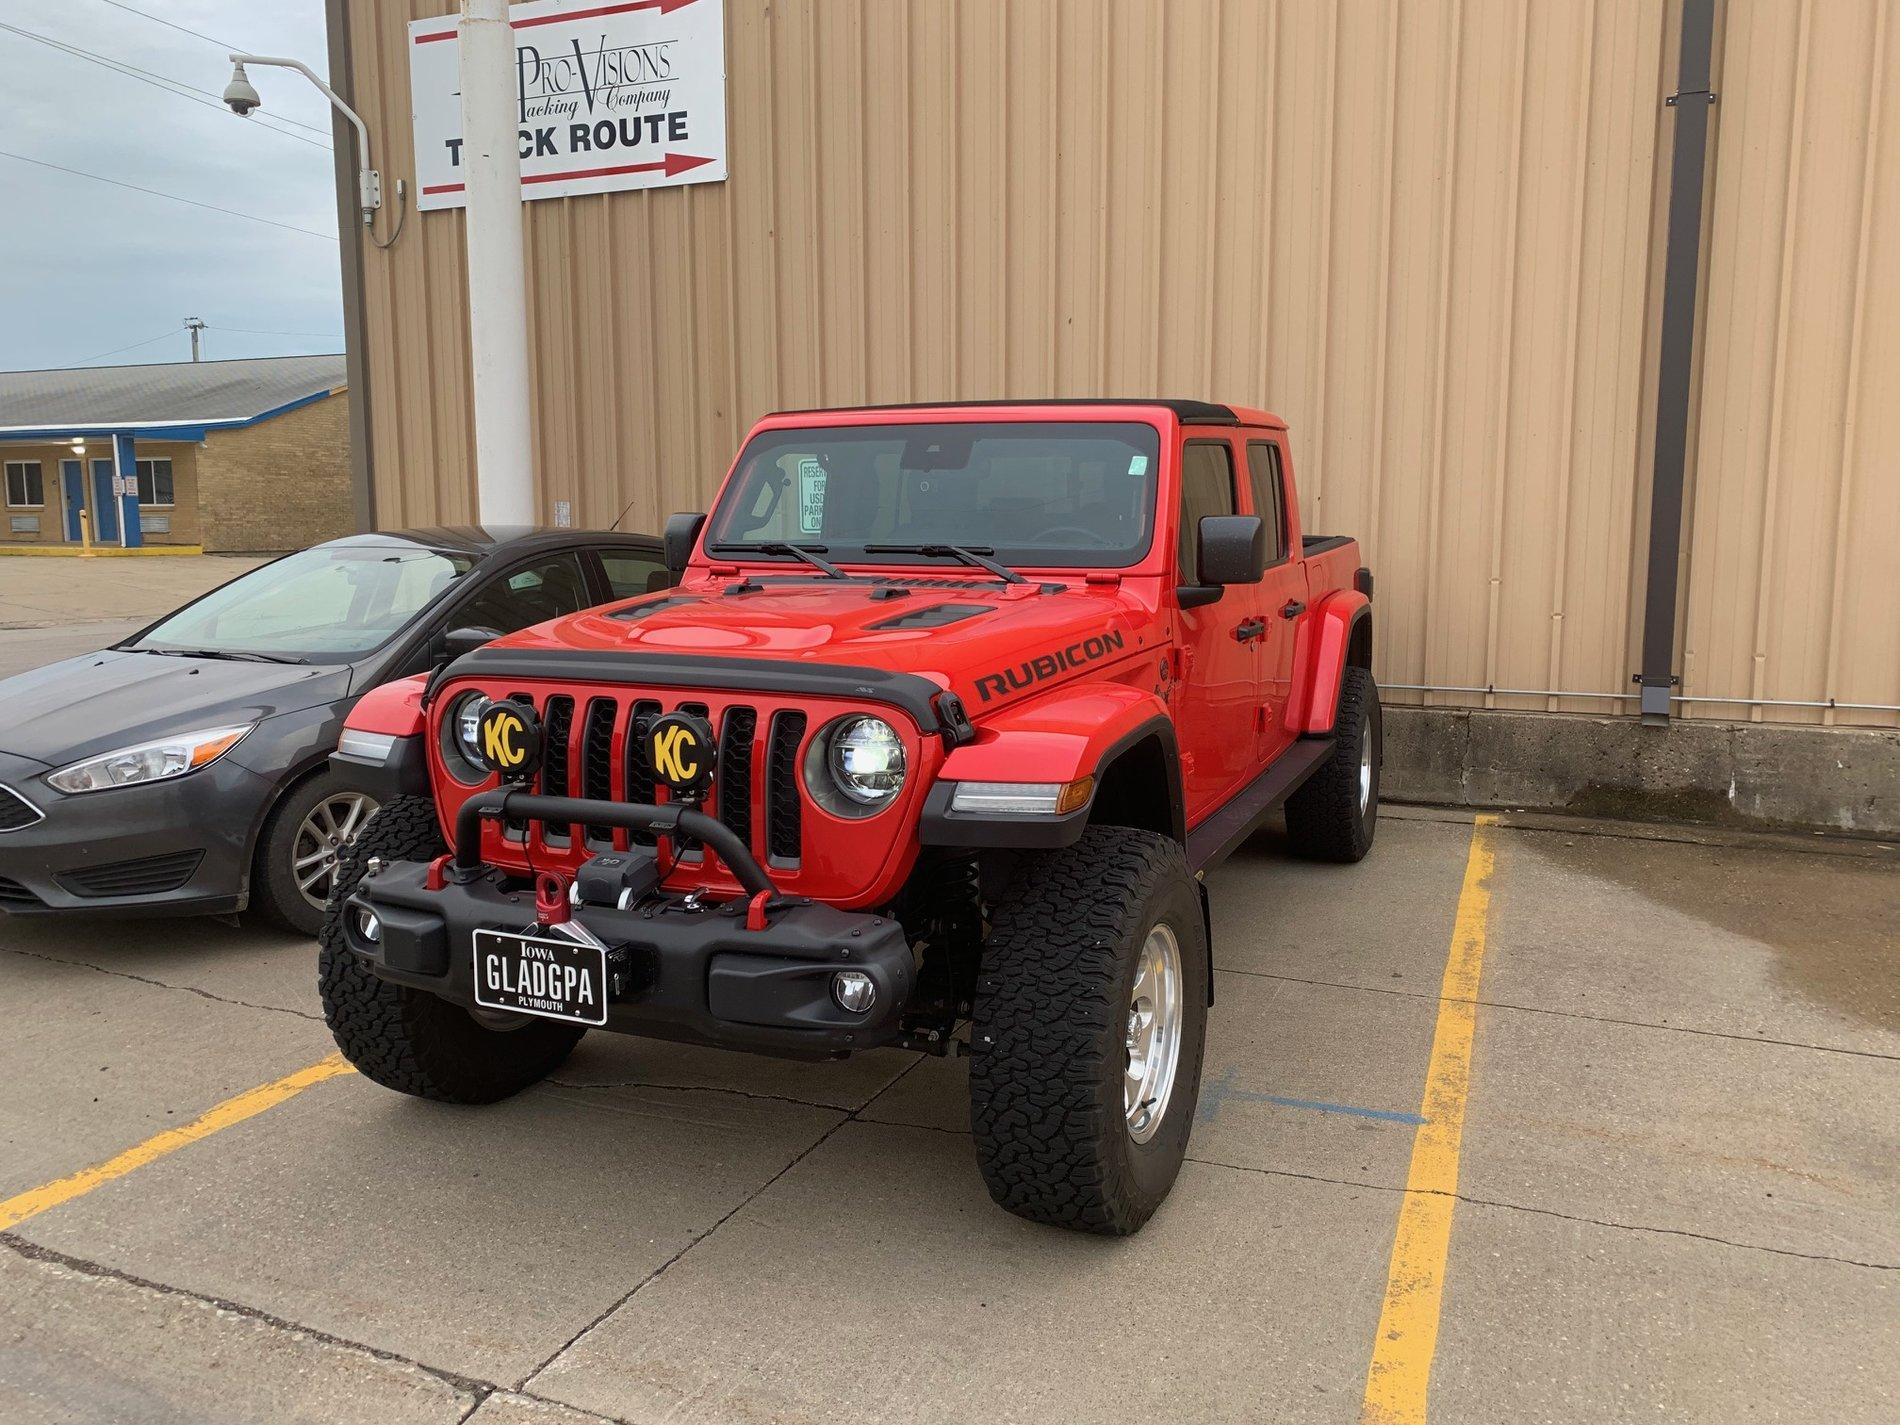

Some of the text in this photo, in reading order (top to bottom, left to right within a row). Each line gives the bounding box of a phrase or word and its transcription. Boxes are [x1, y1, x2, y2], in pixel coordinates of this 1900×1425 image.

[596, 84, 671, 113] Company
[445, 111, 688, 166] TCK ROUTE
[804, 505, 824, 516] PARK
[973, 629, 1125, 703] RUBICON
[483, 712, 525, 768] KC
[653, 725, 698, 782] KC
[520, 941, 555, 962] IOWA
[486, 954, 594, 1005] GLADGPA
[518, 996, 563, 1012] PLYMOUTH
